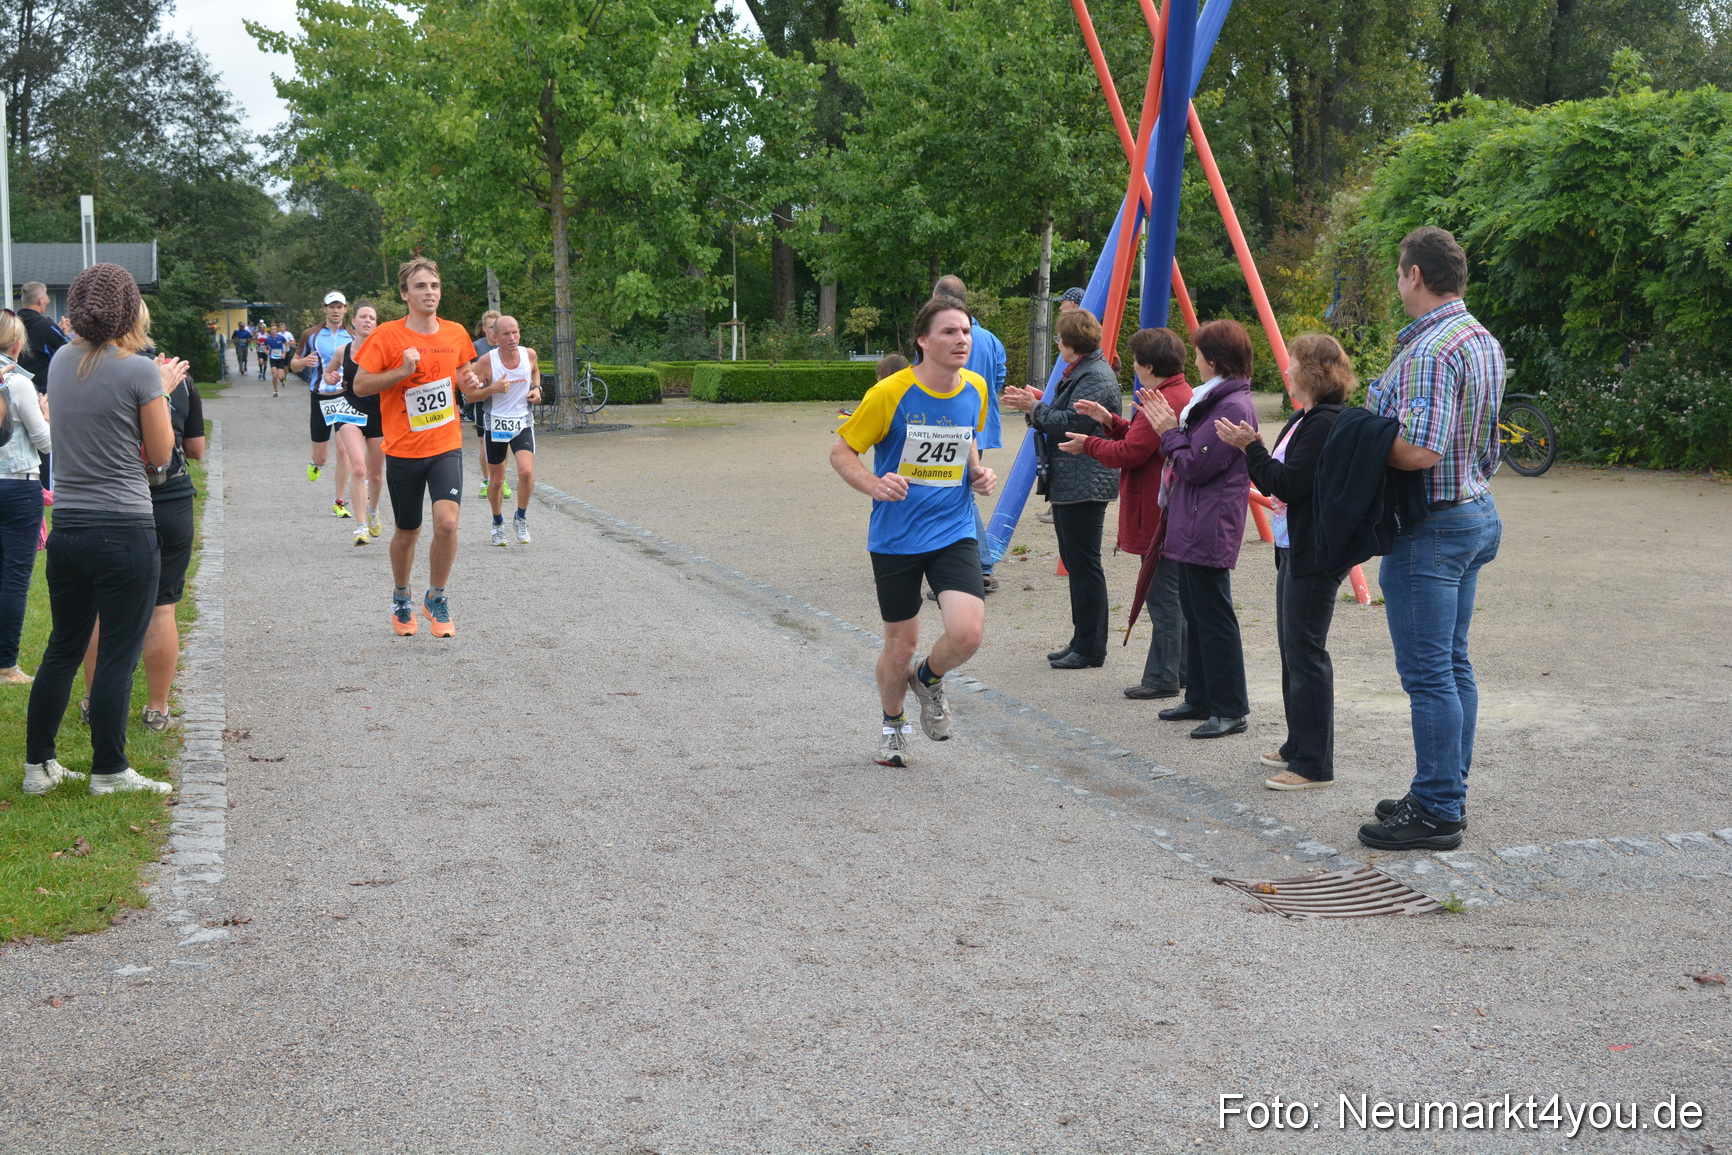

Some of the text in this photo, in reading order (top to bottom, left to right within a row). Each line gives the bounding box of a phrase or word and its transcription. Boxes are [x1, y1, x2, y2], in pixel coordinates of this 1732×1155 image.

[423, 383, 445, 394] Neumarkt
[416, 391, 447, 413] 329
[425, 413, 444, 423] Lukas
[494, 418, 522, 432] 2634
[908, 431, 963, 440] PARTL Neumarkt
[916, 441, 959, 463] 245
[911, 467, 953, 478] Johannes
